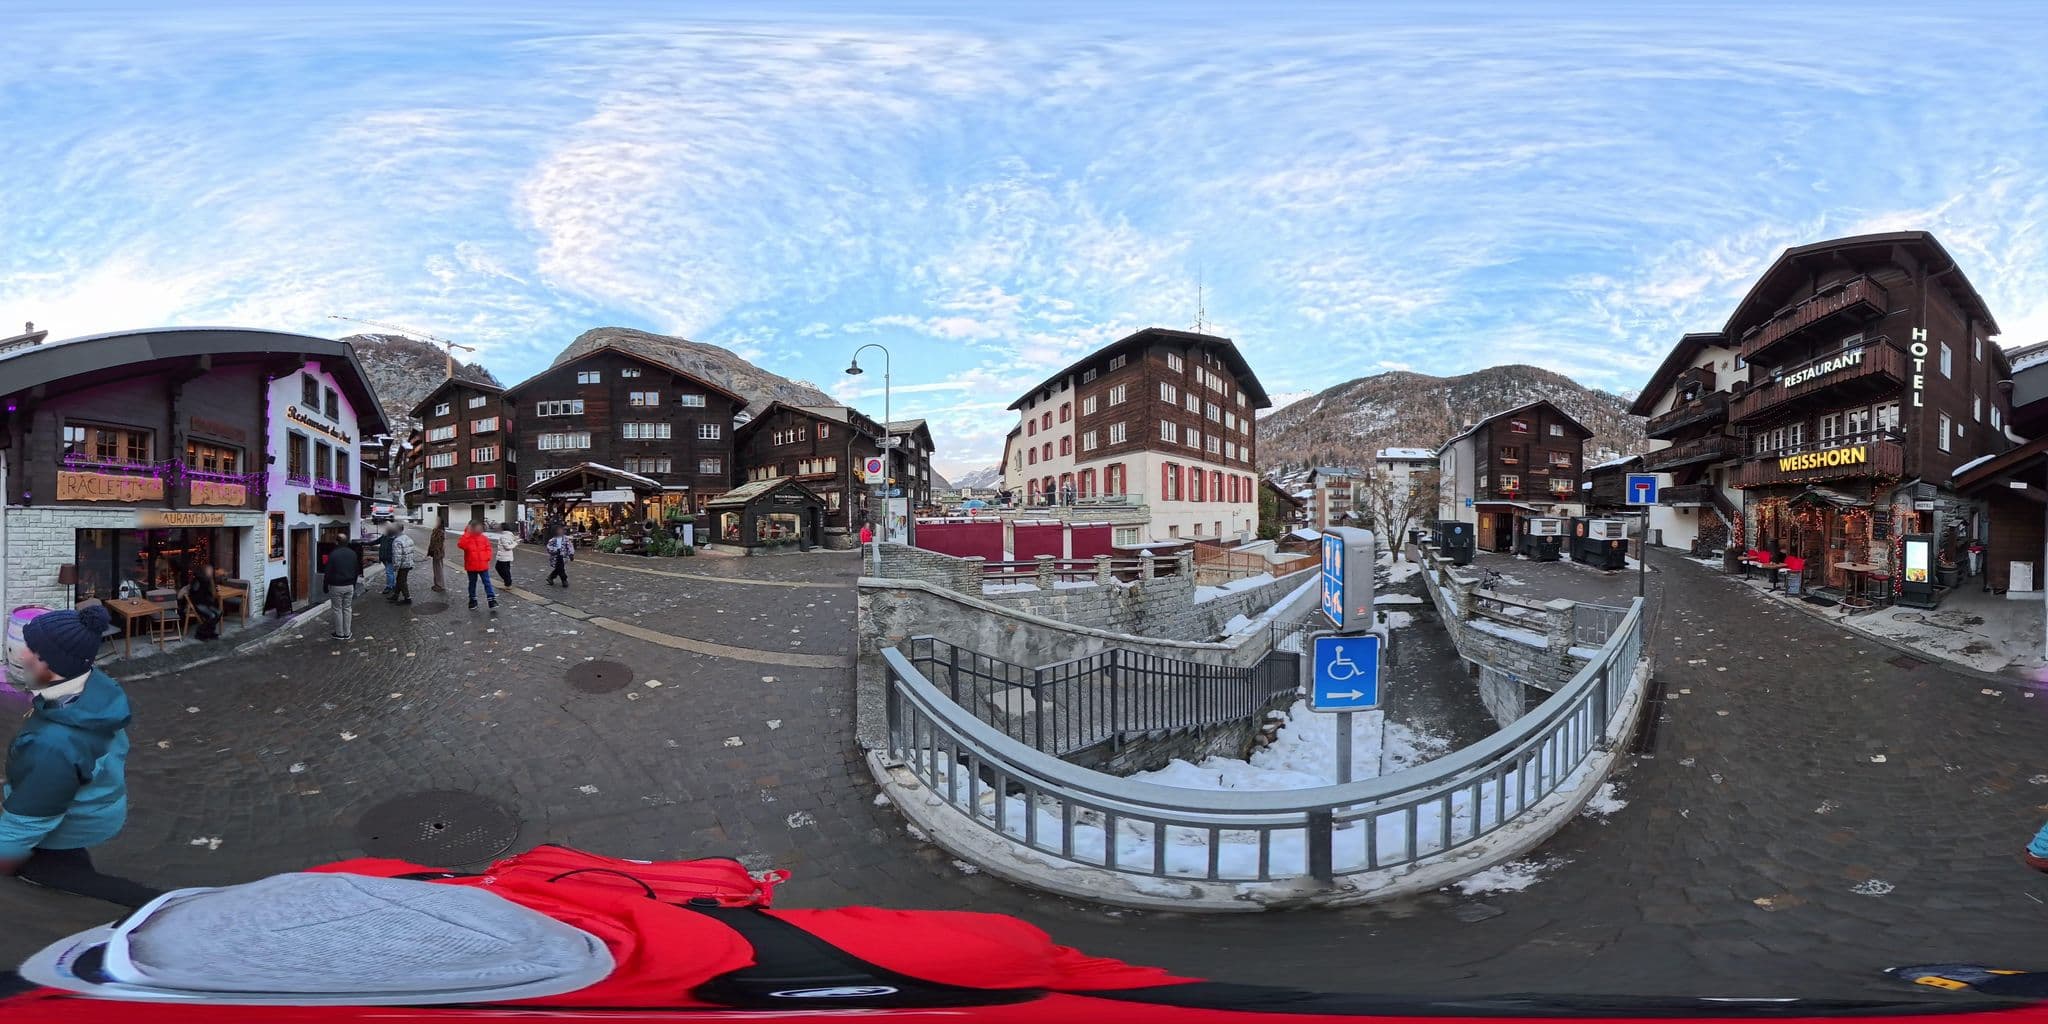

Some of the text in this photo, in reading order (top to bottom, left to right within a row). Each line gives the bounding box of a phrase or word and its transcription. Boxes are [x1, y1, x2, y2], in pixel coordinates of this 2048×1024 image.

[1784, 350, 1866, 388] RESTAURANT
[1910, 327, 1928, 407] HOTEL
[1779, 445, 1866, 473] WEISSHORN
